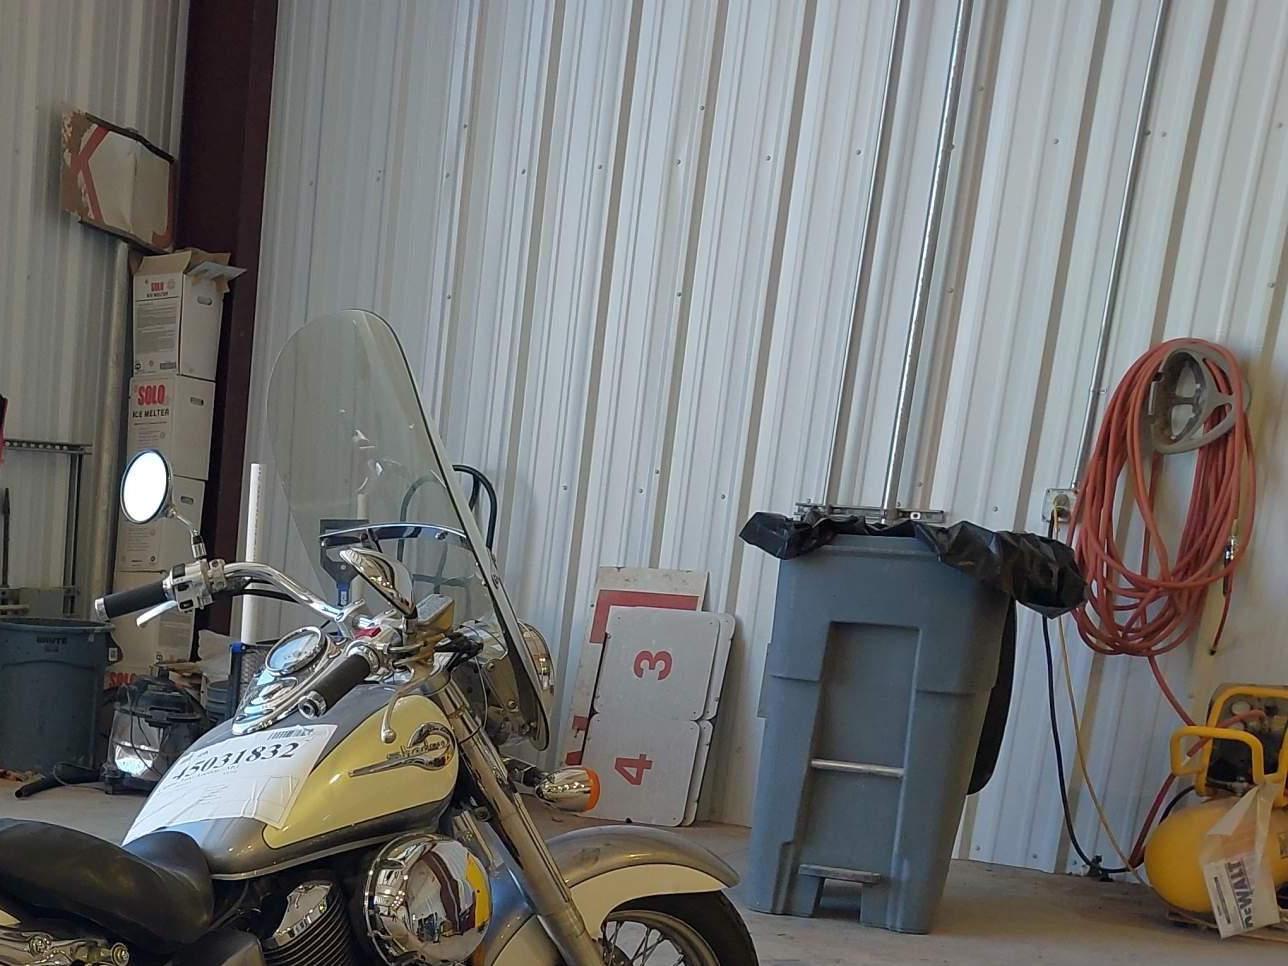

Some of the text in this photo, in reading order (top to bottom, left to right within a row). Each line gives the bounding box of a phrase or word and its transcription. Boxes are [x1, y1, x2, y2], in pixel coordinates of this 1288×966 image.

[138, 384, 166, 405] SOLO
[132, 407, 170, 418] ICE MELTER
[633, 650, 672, 681] 3
[172, 742, 299, 780] 45031832
[615, 753, 653, 786] 4
